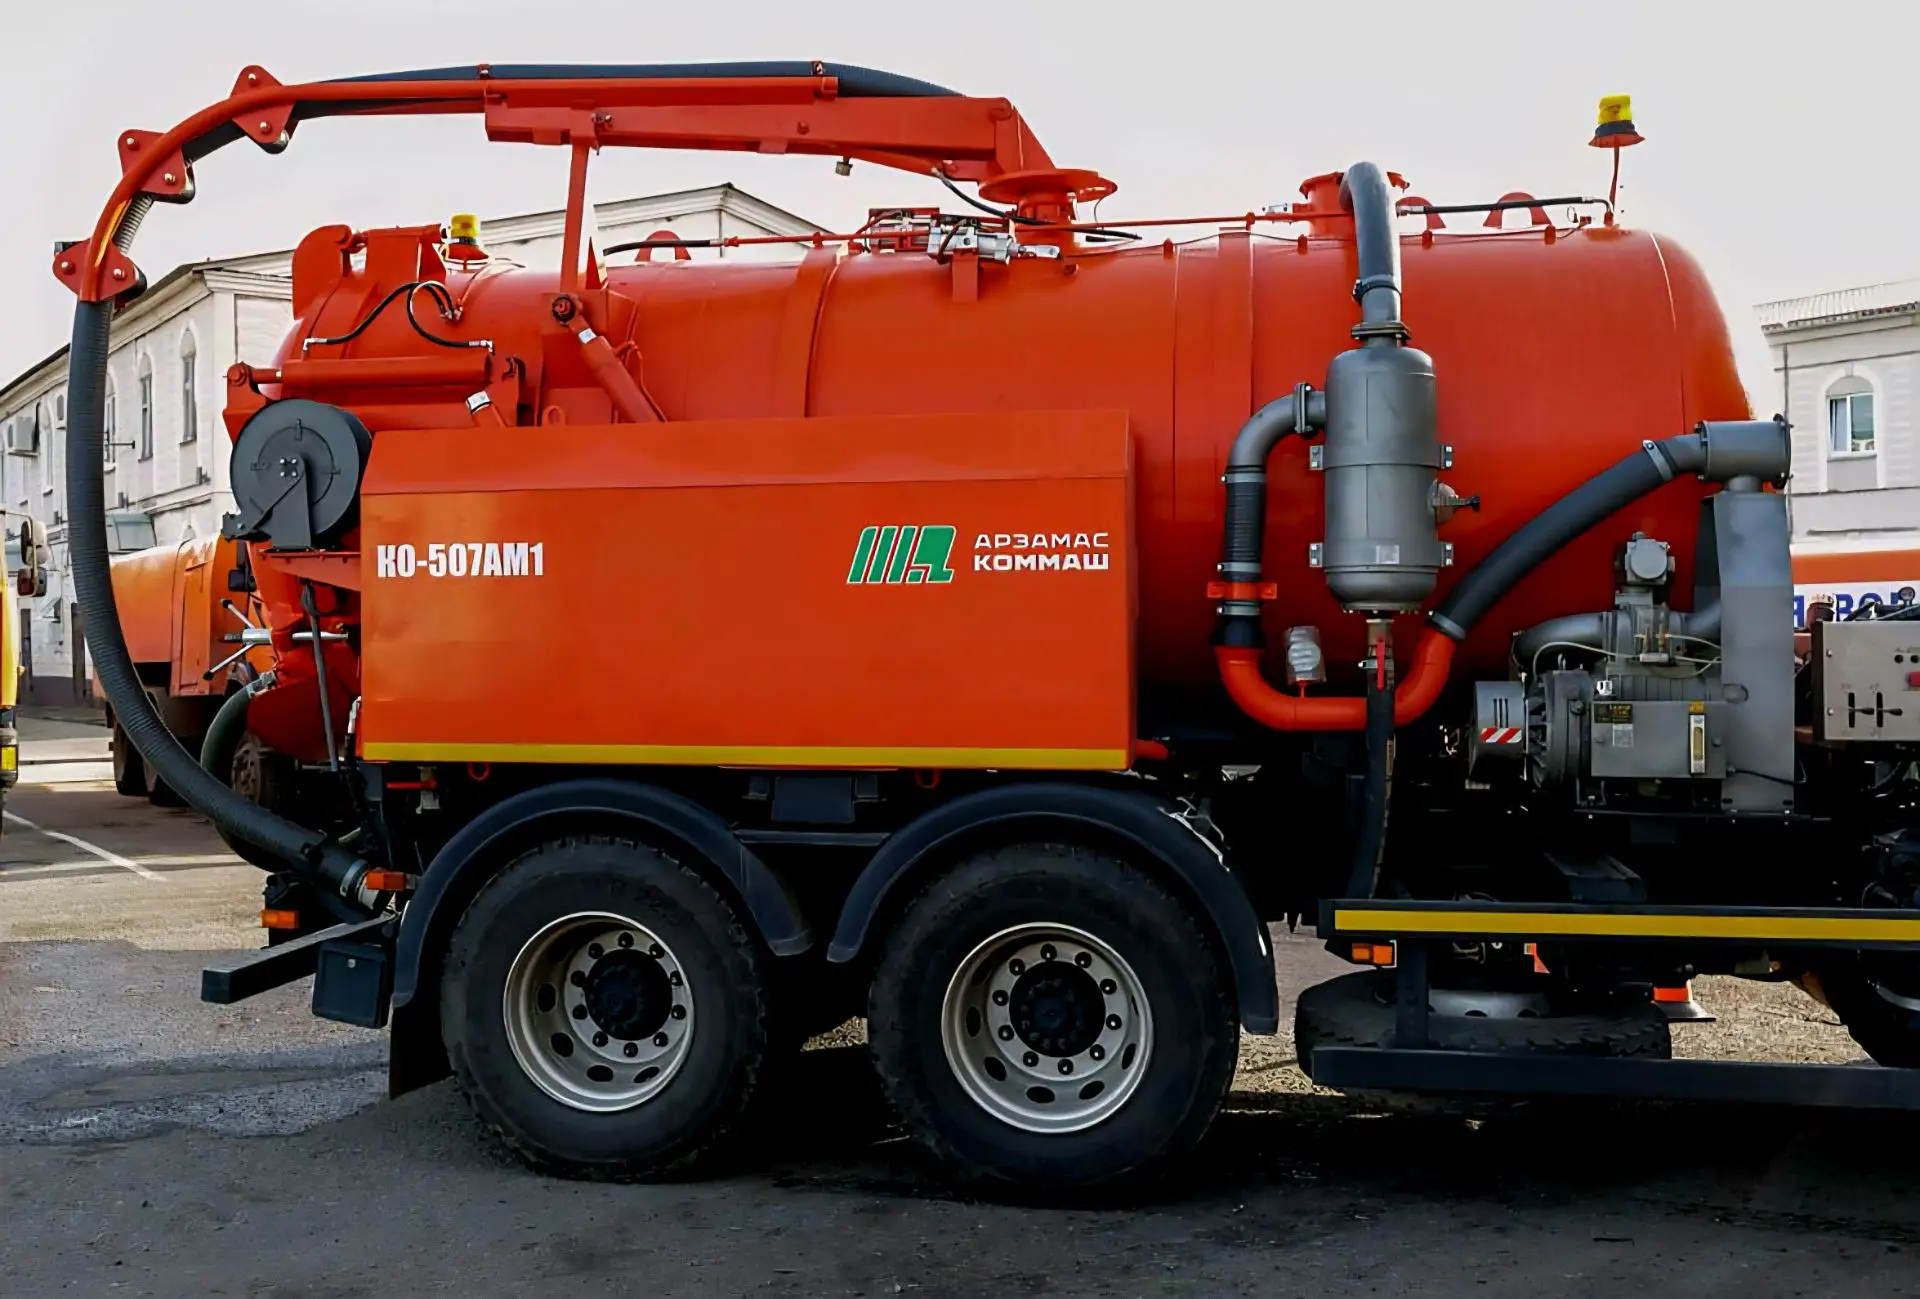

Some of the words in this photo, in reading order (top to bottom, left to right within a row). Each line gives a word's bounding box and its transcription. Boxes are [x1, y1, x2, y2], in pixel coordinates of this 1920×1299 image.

[974, 532, 1109, 549] АРЗАМАС
[377, 542, 544, 578] КО-507АМ1
[974, 554, 1109, 571] КОММАШ
